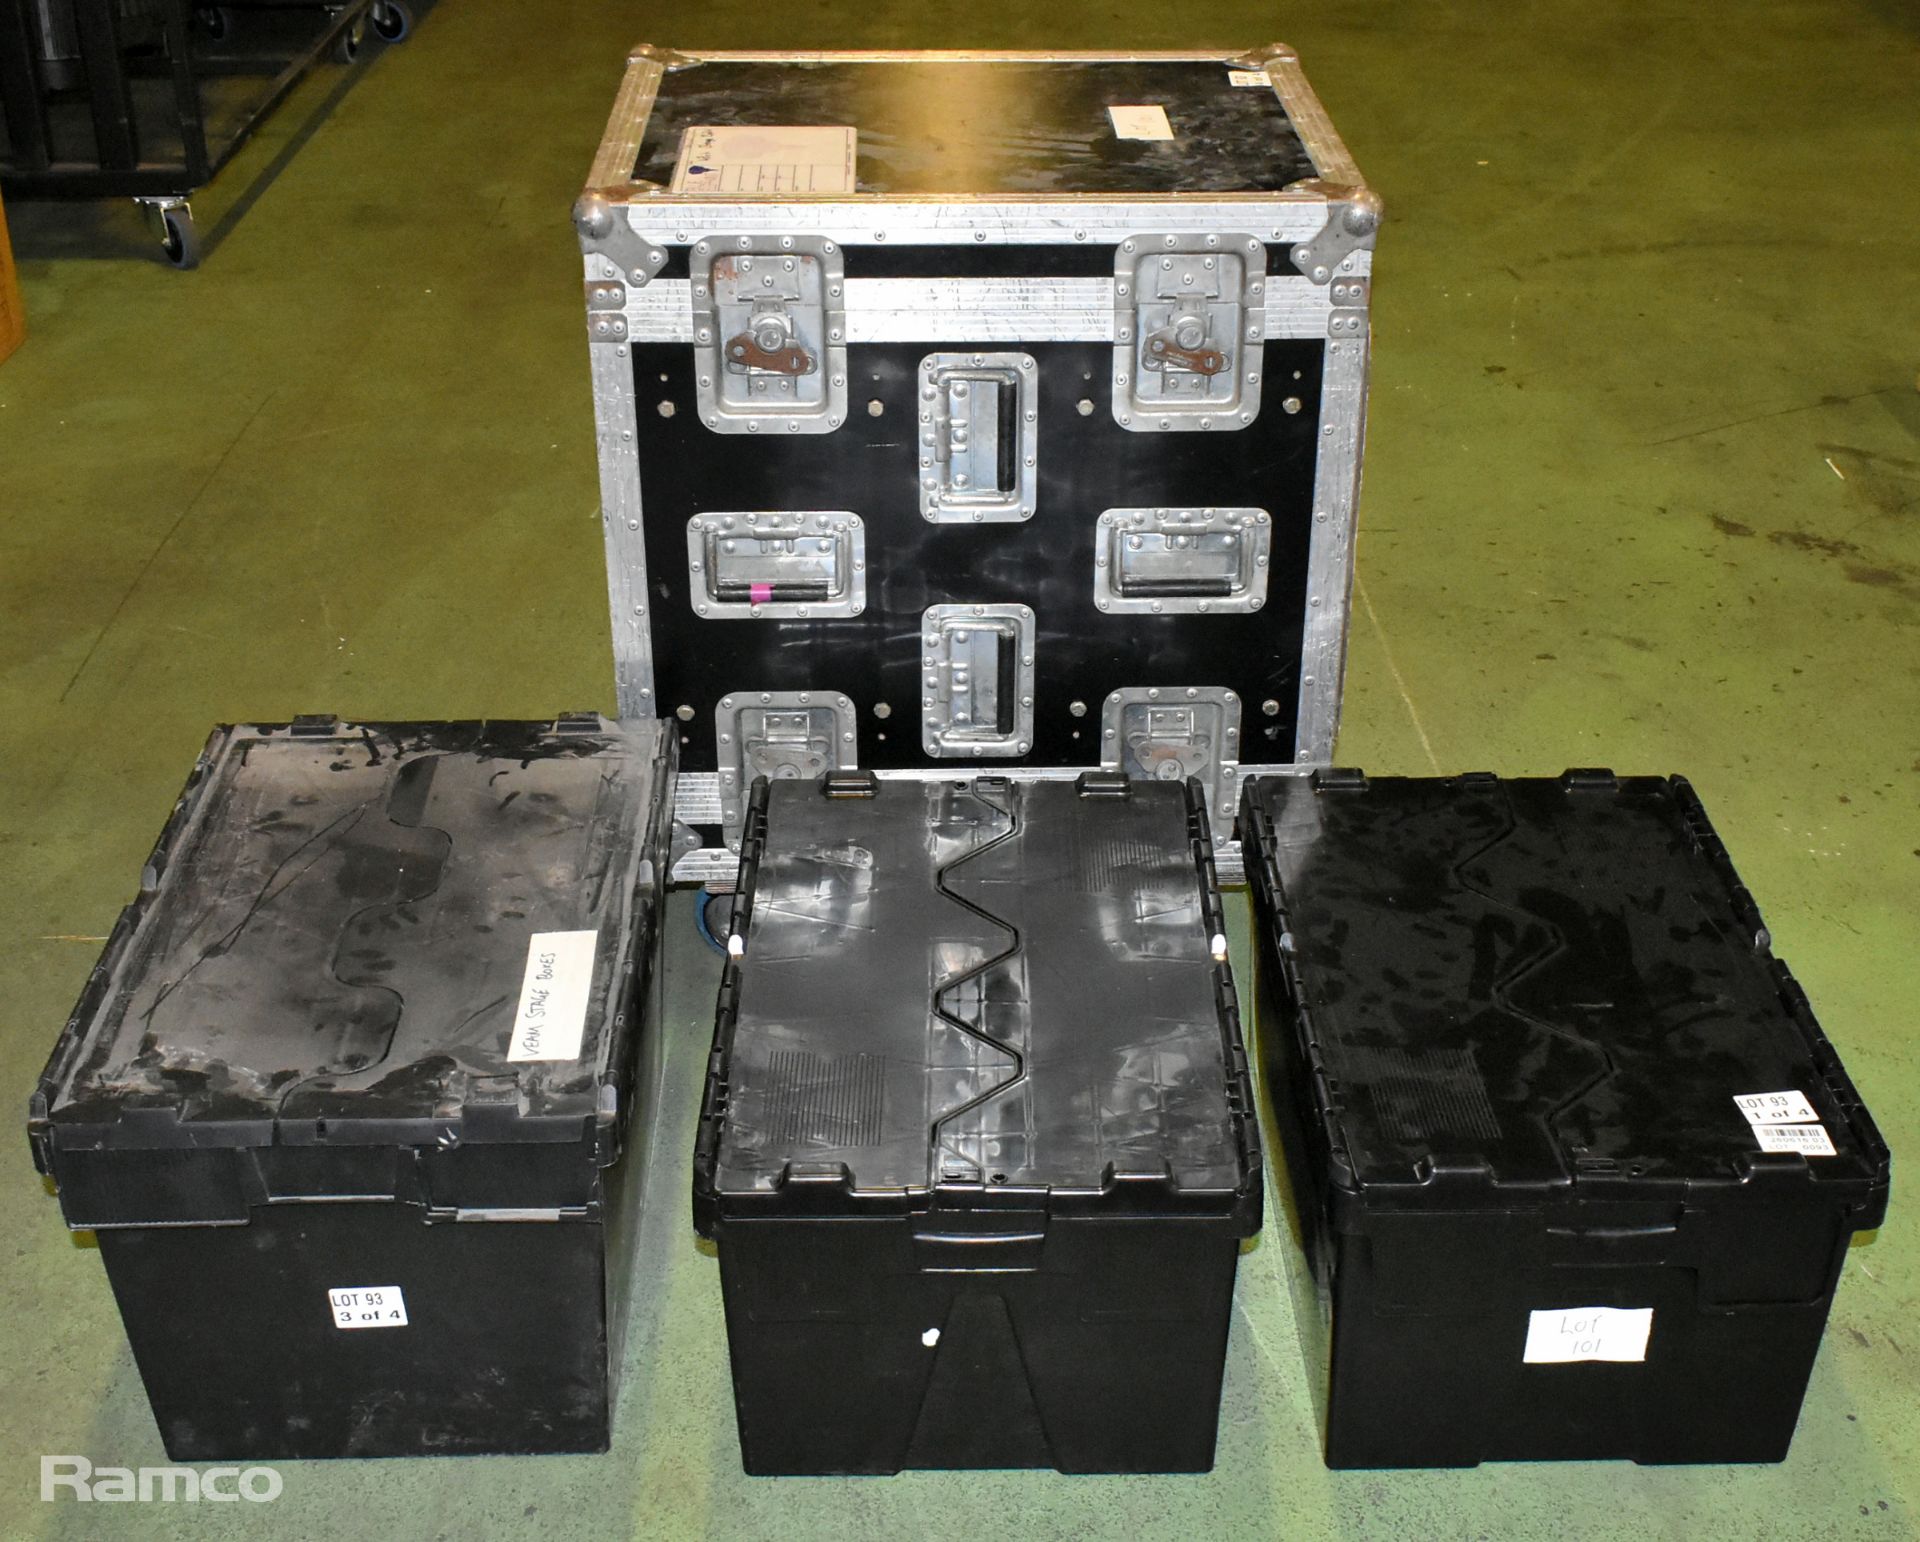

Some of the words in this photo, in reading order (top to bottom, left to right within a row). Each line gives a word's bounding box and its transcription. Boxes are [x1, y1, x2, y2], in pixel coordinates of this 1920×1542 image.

[1737, 1097, 1765, 1110] LOT
[1769, 1096, 1789, 1107] 93
[1752, 1111, 1761, 1119] 1
[1771, 1109, 1790, 1118] of
[1798, 1108, 1810, 1116] 4
[331, 1293, 359, 1307] LOT
[365, 1292, 384, 1306] 93
[340, 1311, 352, 1321] 3
[361, 1310, 380, 1321] of
[389, 1309, 401, 1319] 4
[1560, 1314, 1603, 1335] LOT
[1572, 1338, 1602, 1355] 101
